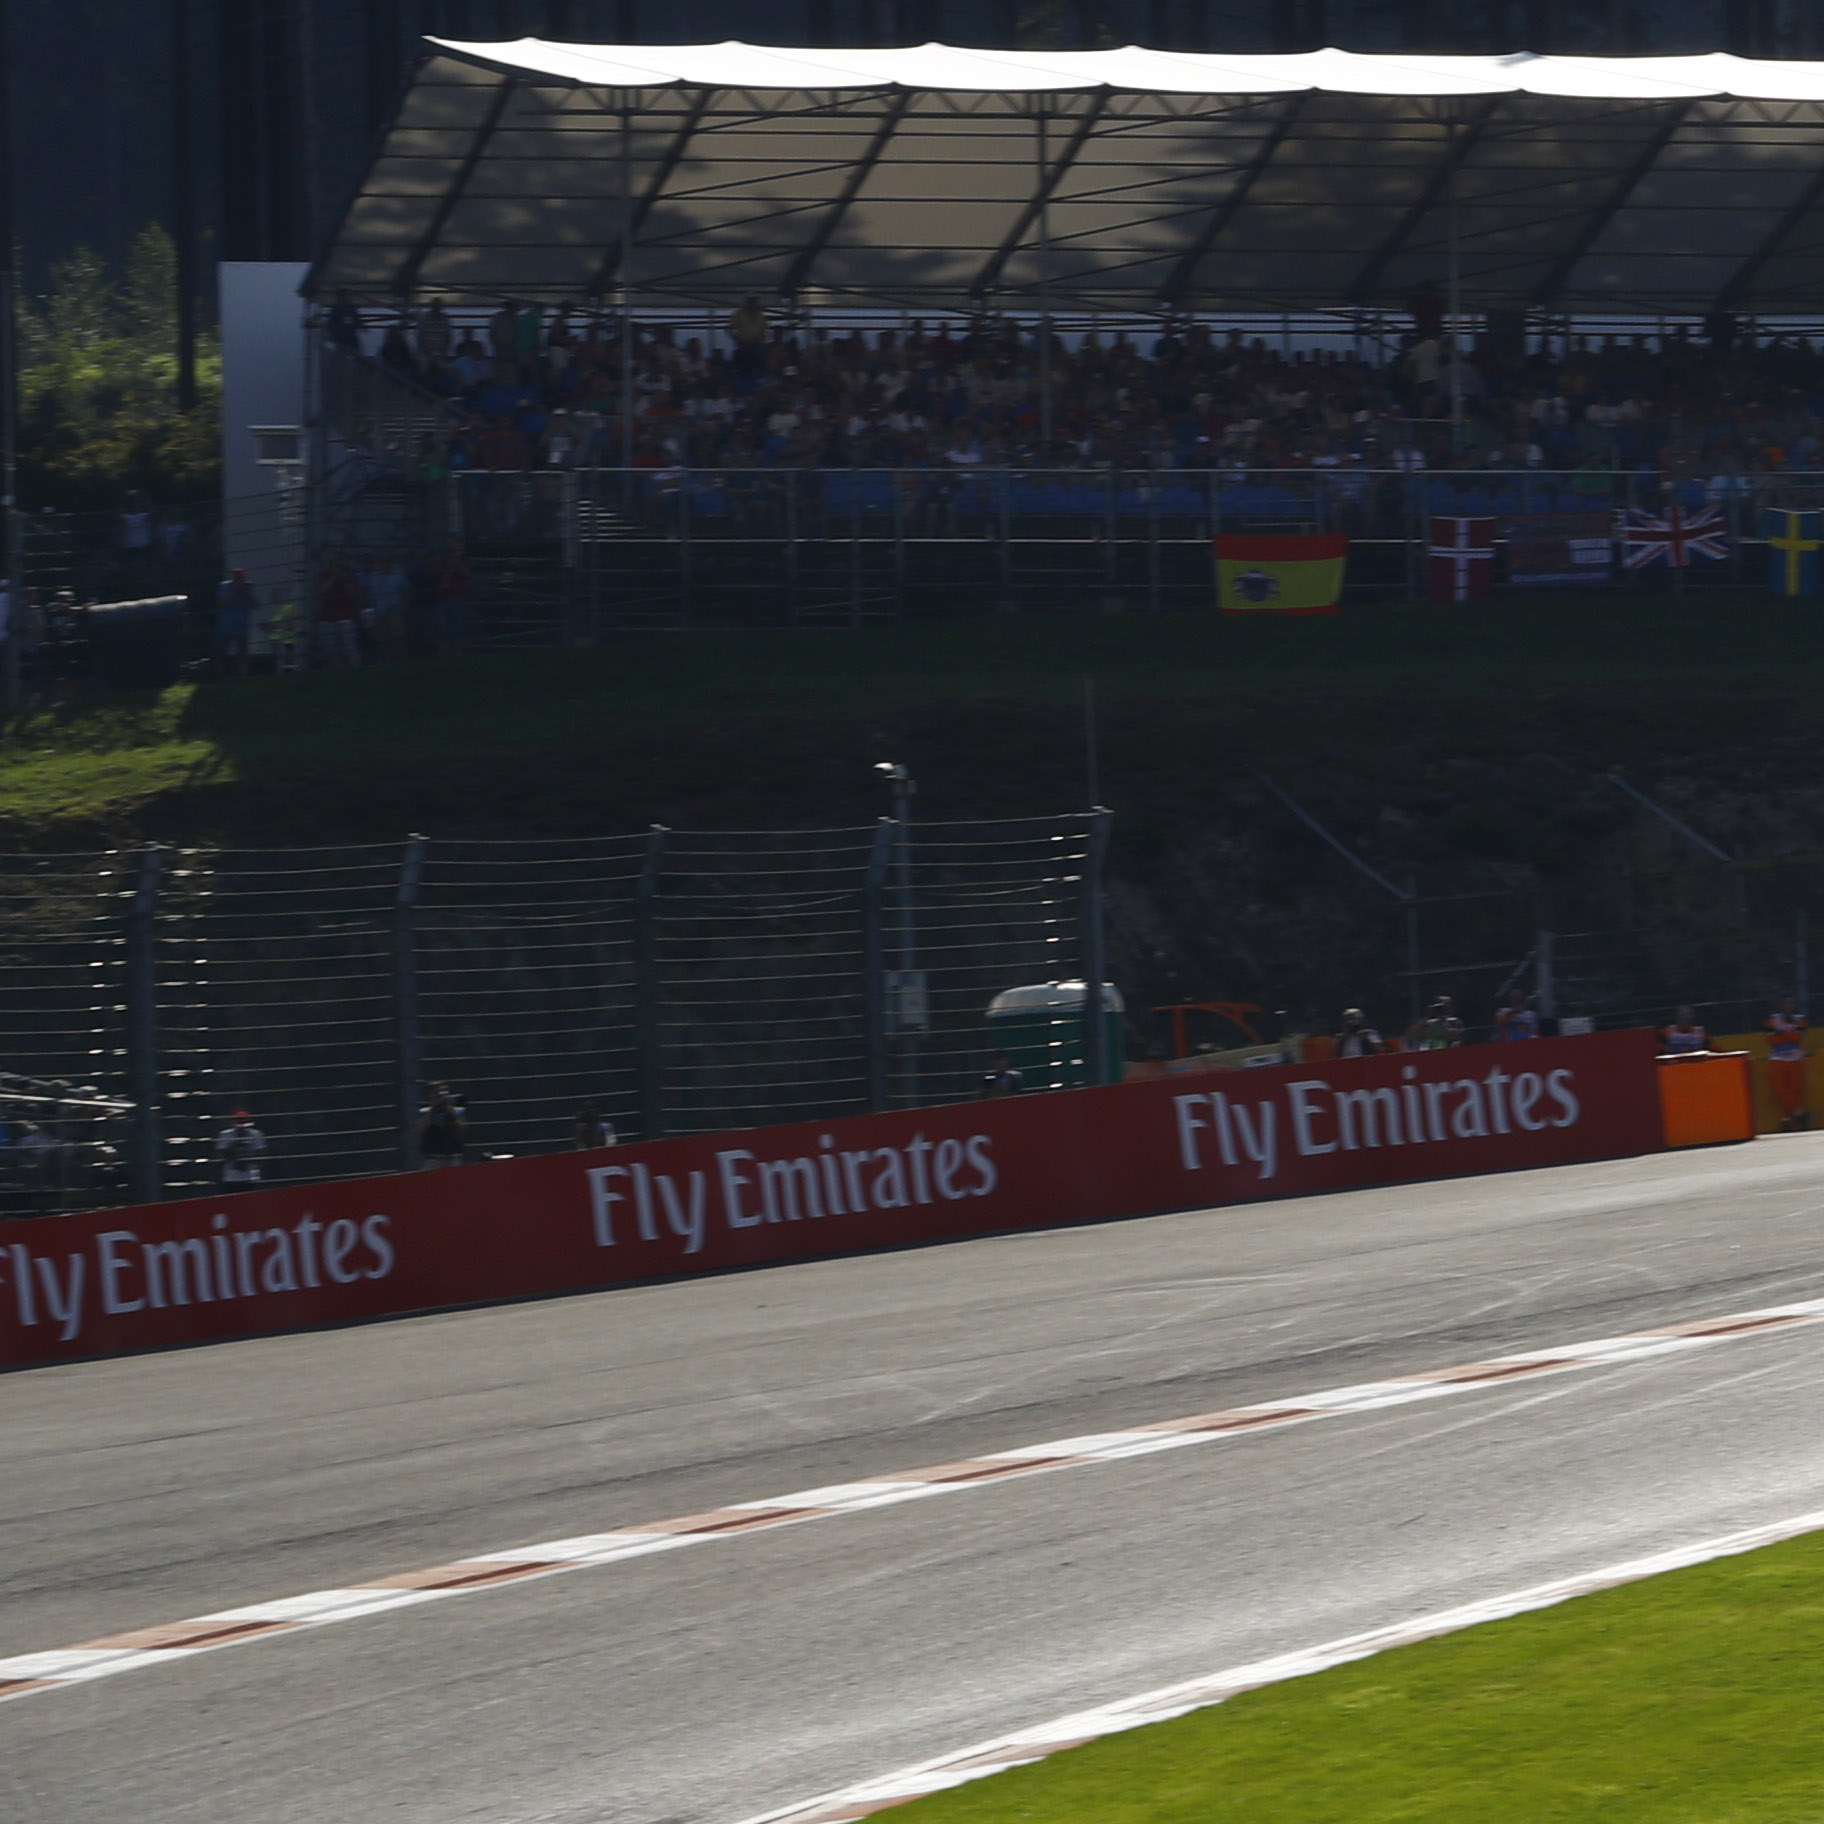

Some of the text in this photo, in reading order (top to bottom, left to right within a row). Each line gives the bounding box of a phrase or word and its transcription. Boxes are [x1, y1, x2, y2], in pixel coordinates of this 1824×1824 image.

[1173, 1065, 1580, 1179] Fly Emirates
[586, 1133, 997, 1254] Fly Emirates
[0, 1213, 395, 1341] ly Emirates
